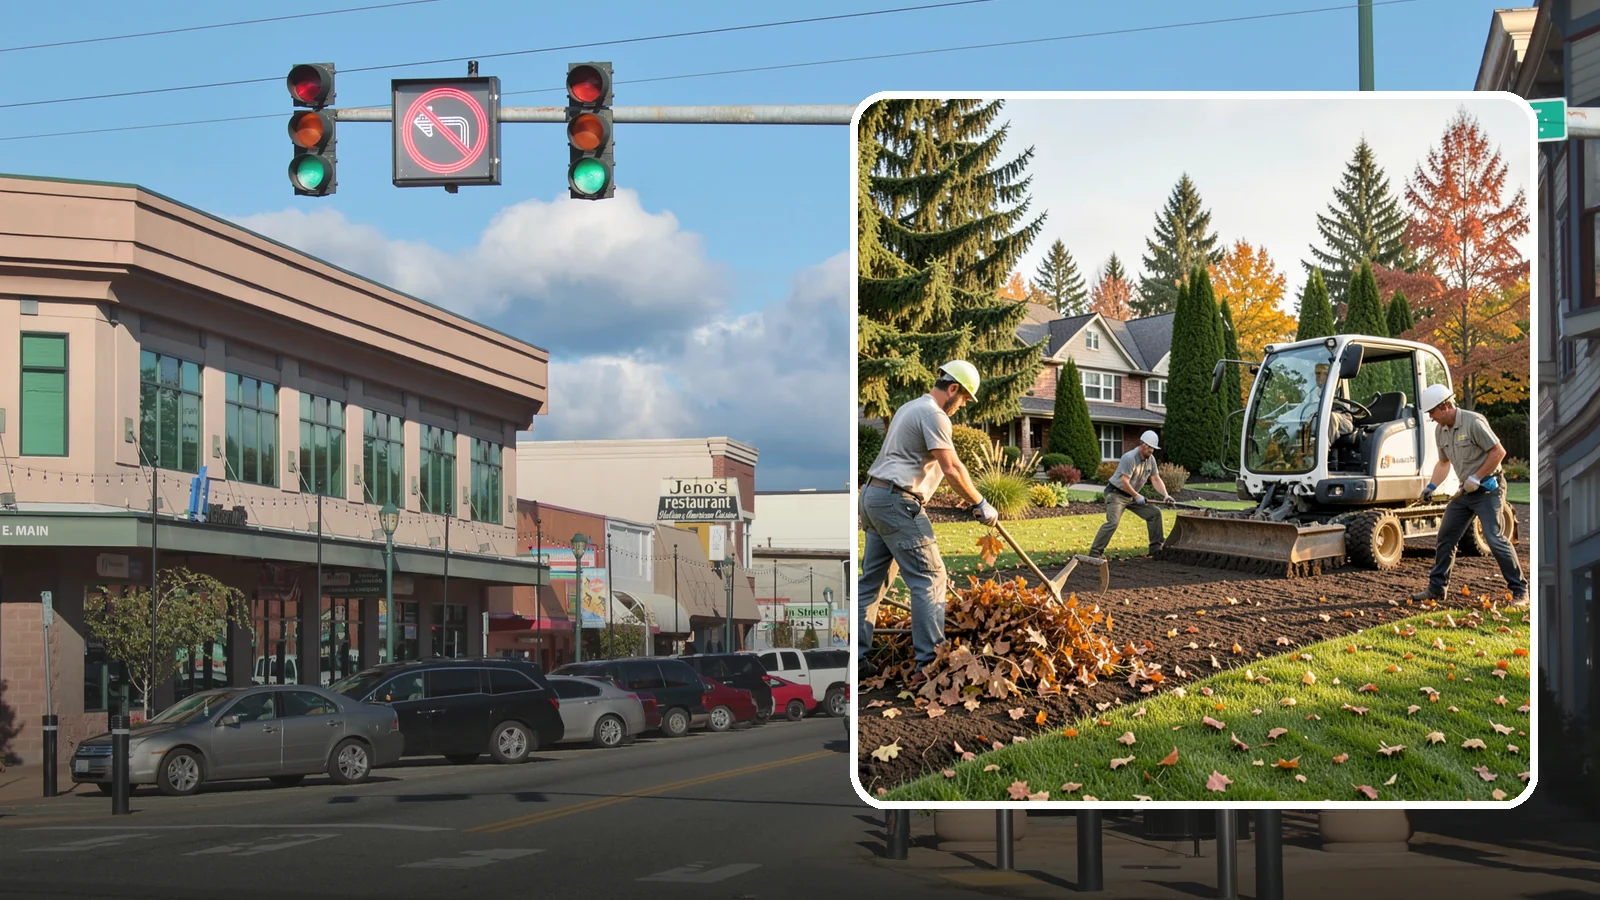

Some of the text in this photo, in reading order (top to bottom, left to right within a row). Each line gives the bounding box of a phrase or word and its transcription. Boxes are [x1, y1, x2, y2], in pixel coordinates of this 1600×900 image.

[670, 480, 727, 494] Jeno's
[665, 497, 731, 509] restaurant
[658, 510, 681, 519] Italian
[686, 510, 714, 519] American
[715, 510, 737, 519] Cuisine
[2, 525, 49, 536] E. MAIN
[786, 607, 795, 617] in
[798, 607, 828, 617] Street
[790, 619, 824, 627] lass
